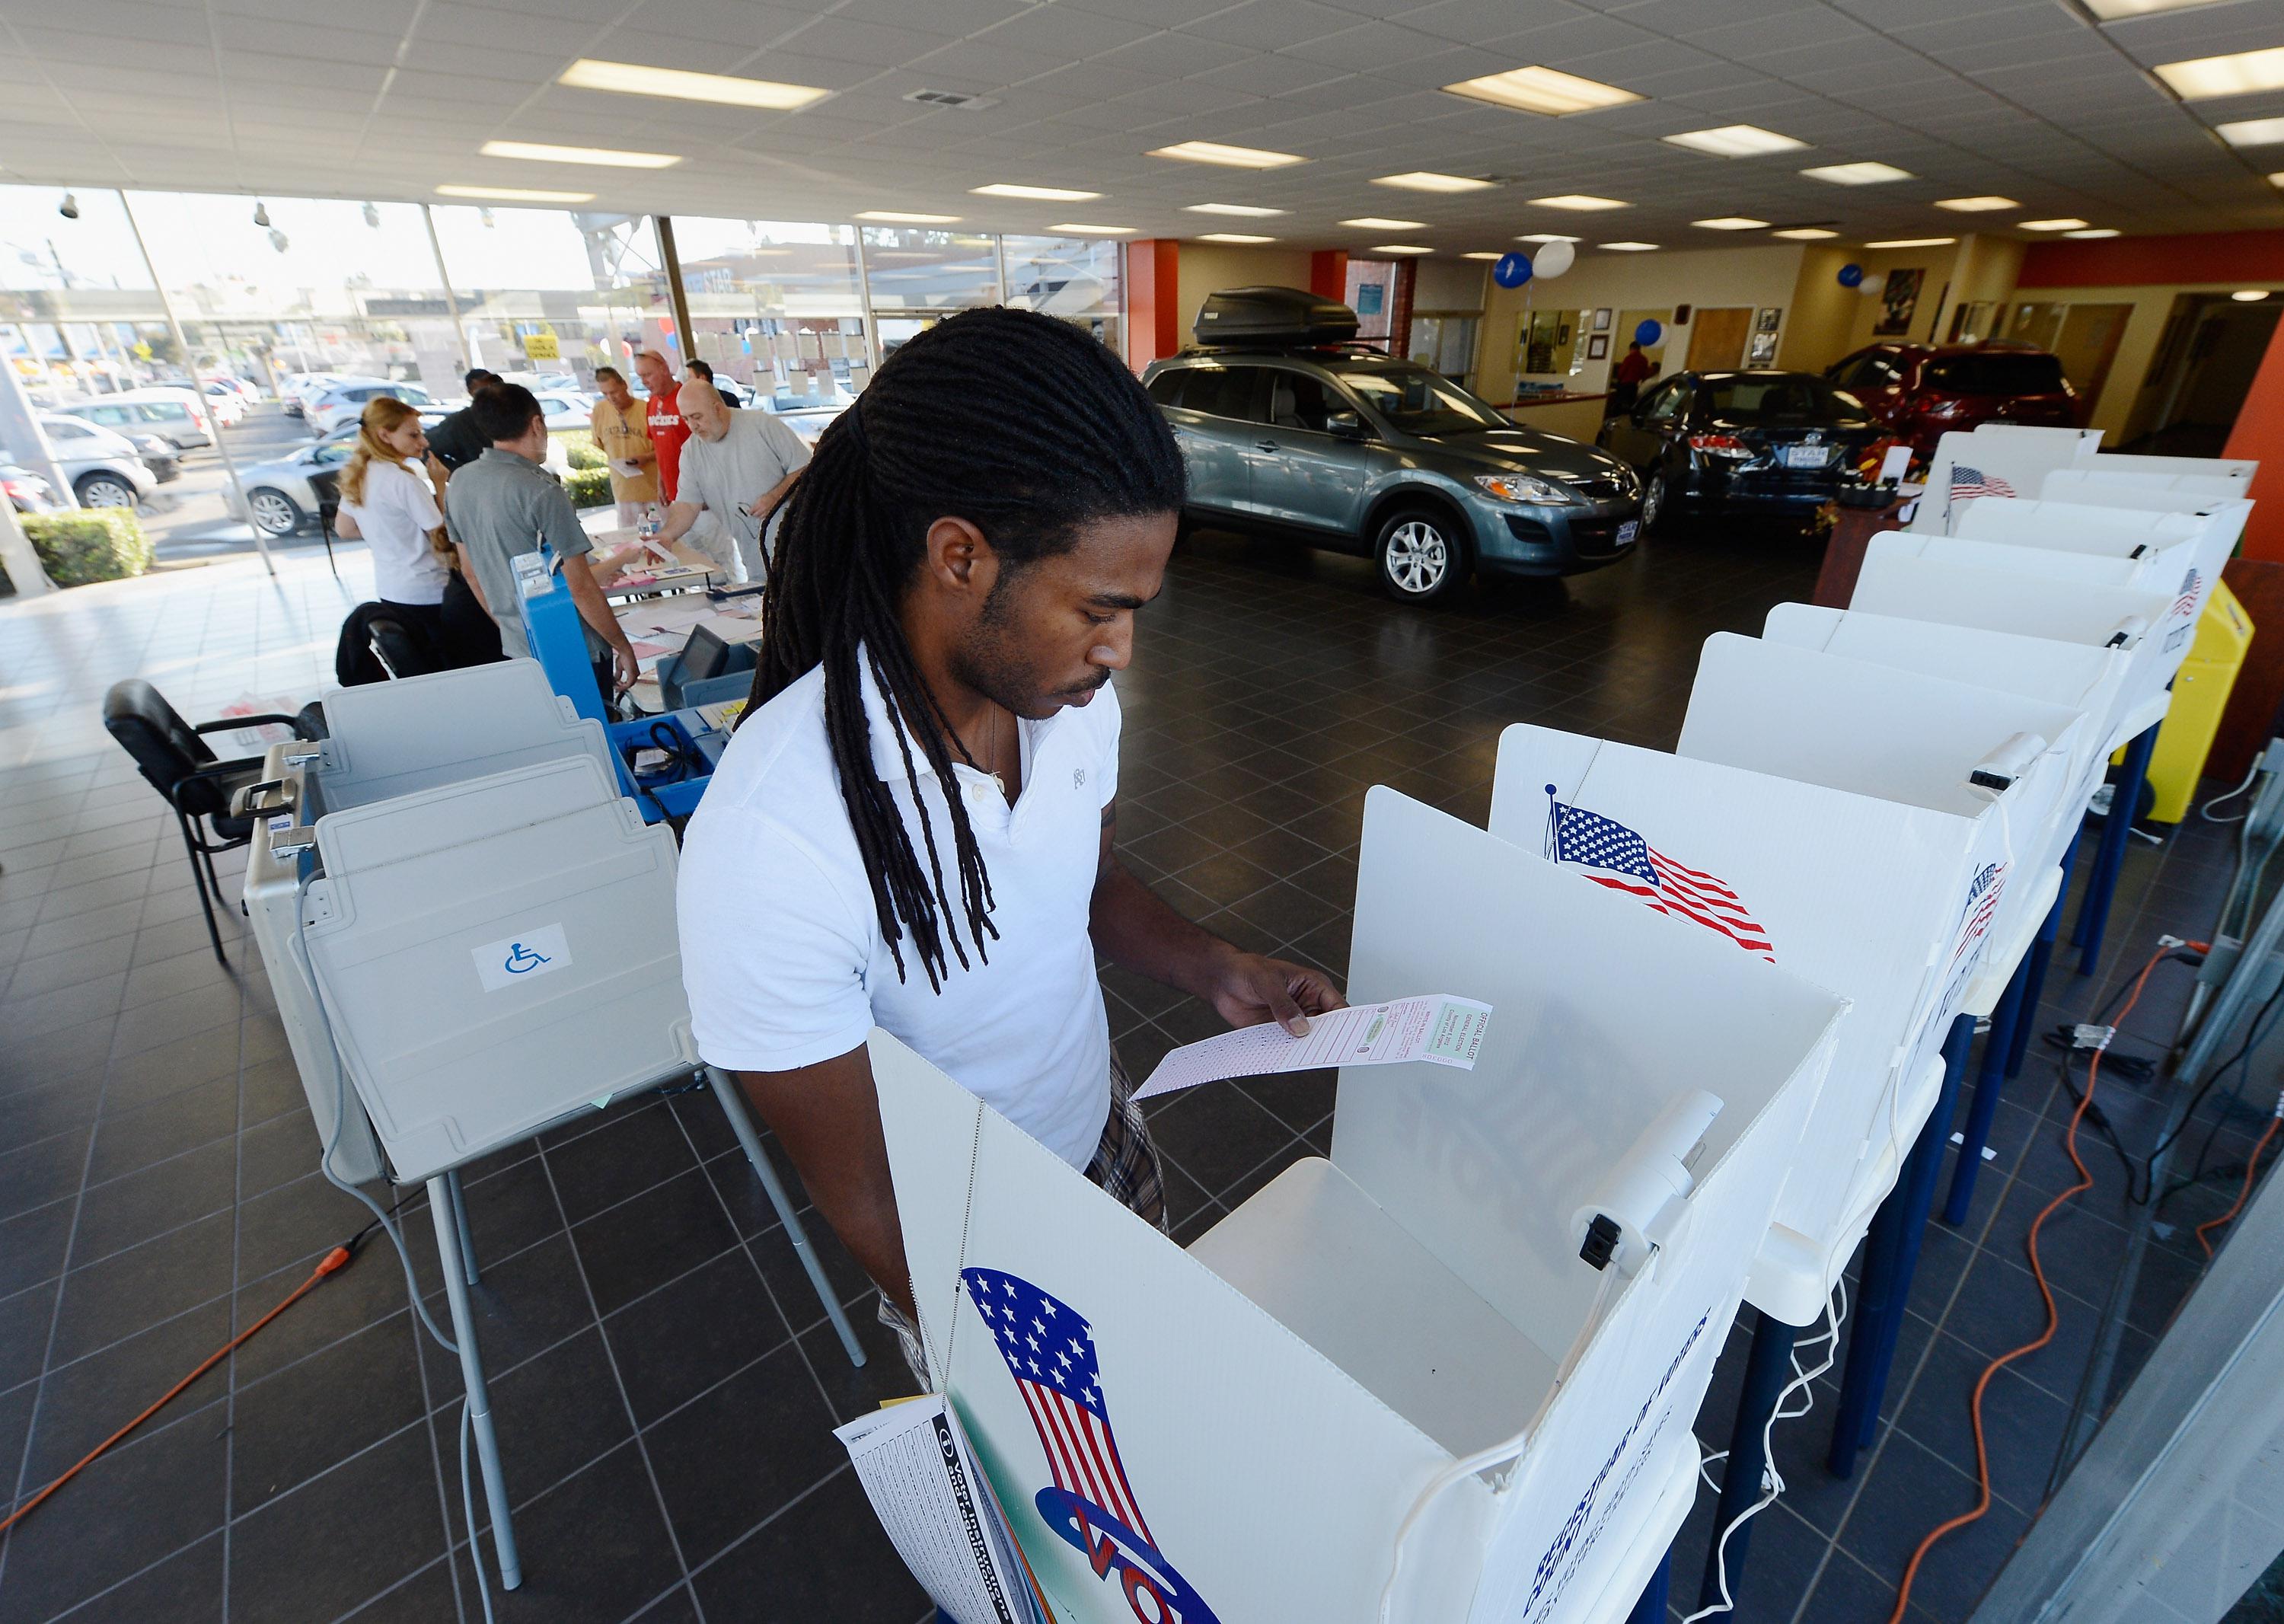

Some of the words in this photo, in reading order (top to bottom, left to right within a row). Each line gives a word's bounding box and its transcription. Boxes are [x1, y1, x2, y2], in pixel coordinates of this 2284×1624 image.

[1450, 1014, 1459, 1032] November
[1461, 1013, 1473, 1032] GENERAL
[1473, 1012, 1488, 1039] OFFICIAL
[1415, 1027, 1424, 1044] BALLOT
[1436, 1034, 1446, 1048] Angeles
[1455, 1032, 1467, 1052] ELECTION
[1466, 1037, 1480, 1060] BALLOT
[1533, 1426, 1632, 1588] REGISTRAR
[1633, 1386, 1657, 1435] OF
[1657, 1306, 1711, 1399] VOTERS
[948, 1465, 962, 1498] and
[959, 1503, 997, 1602] regulations
[953, 1461, 971, 1509] Voter
[968, 1512, 1010, 1622] instructions
[1072, 1502, 1186, 1624] VO
[1523, 1501, 1594, 1618] COUNTY
